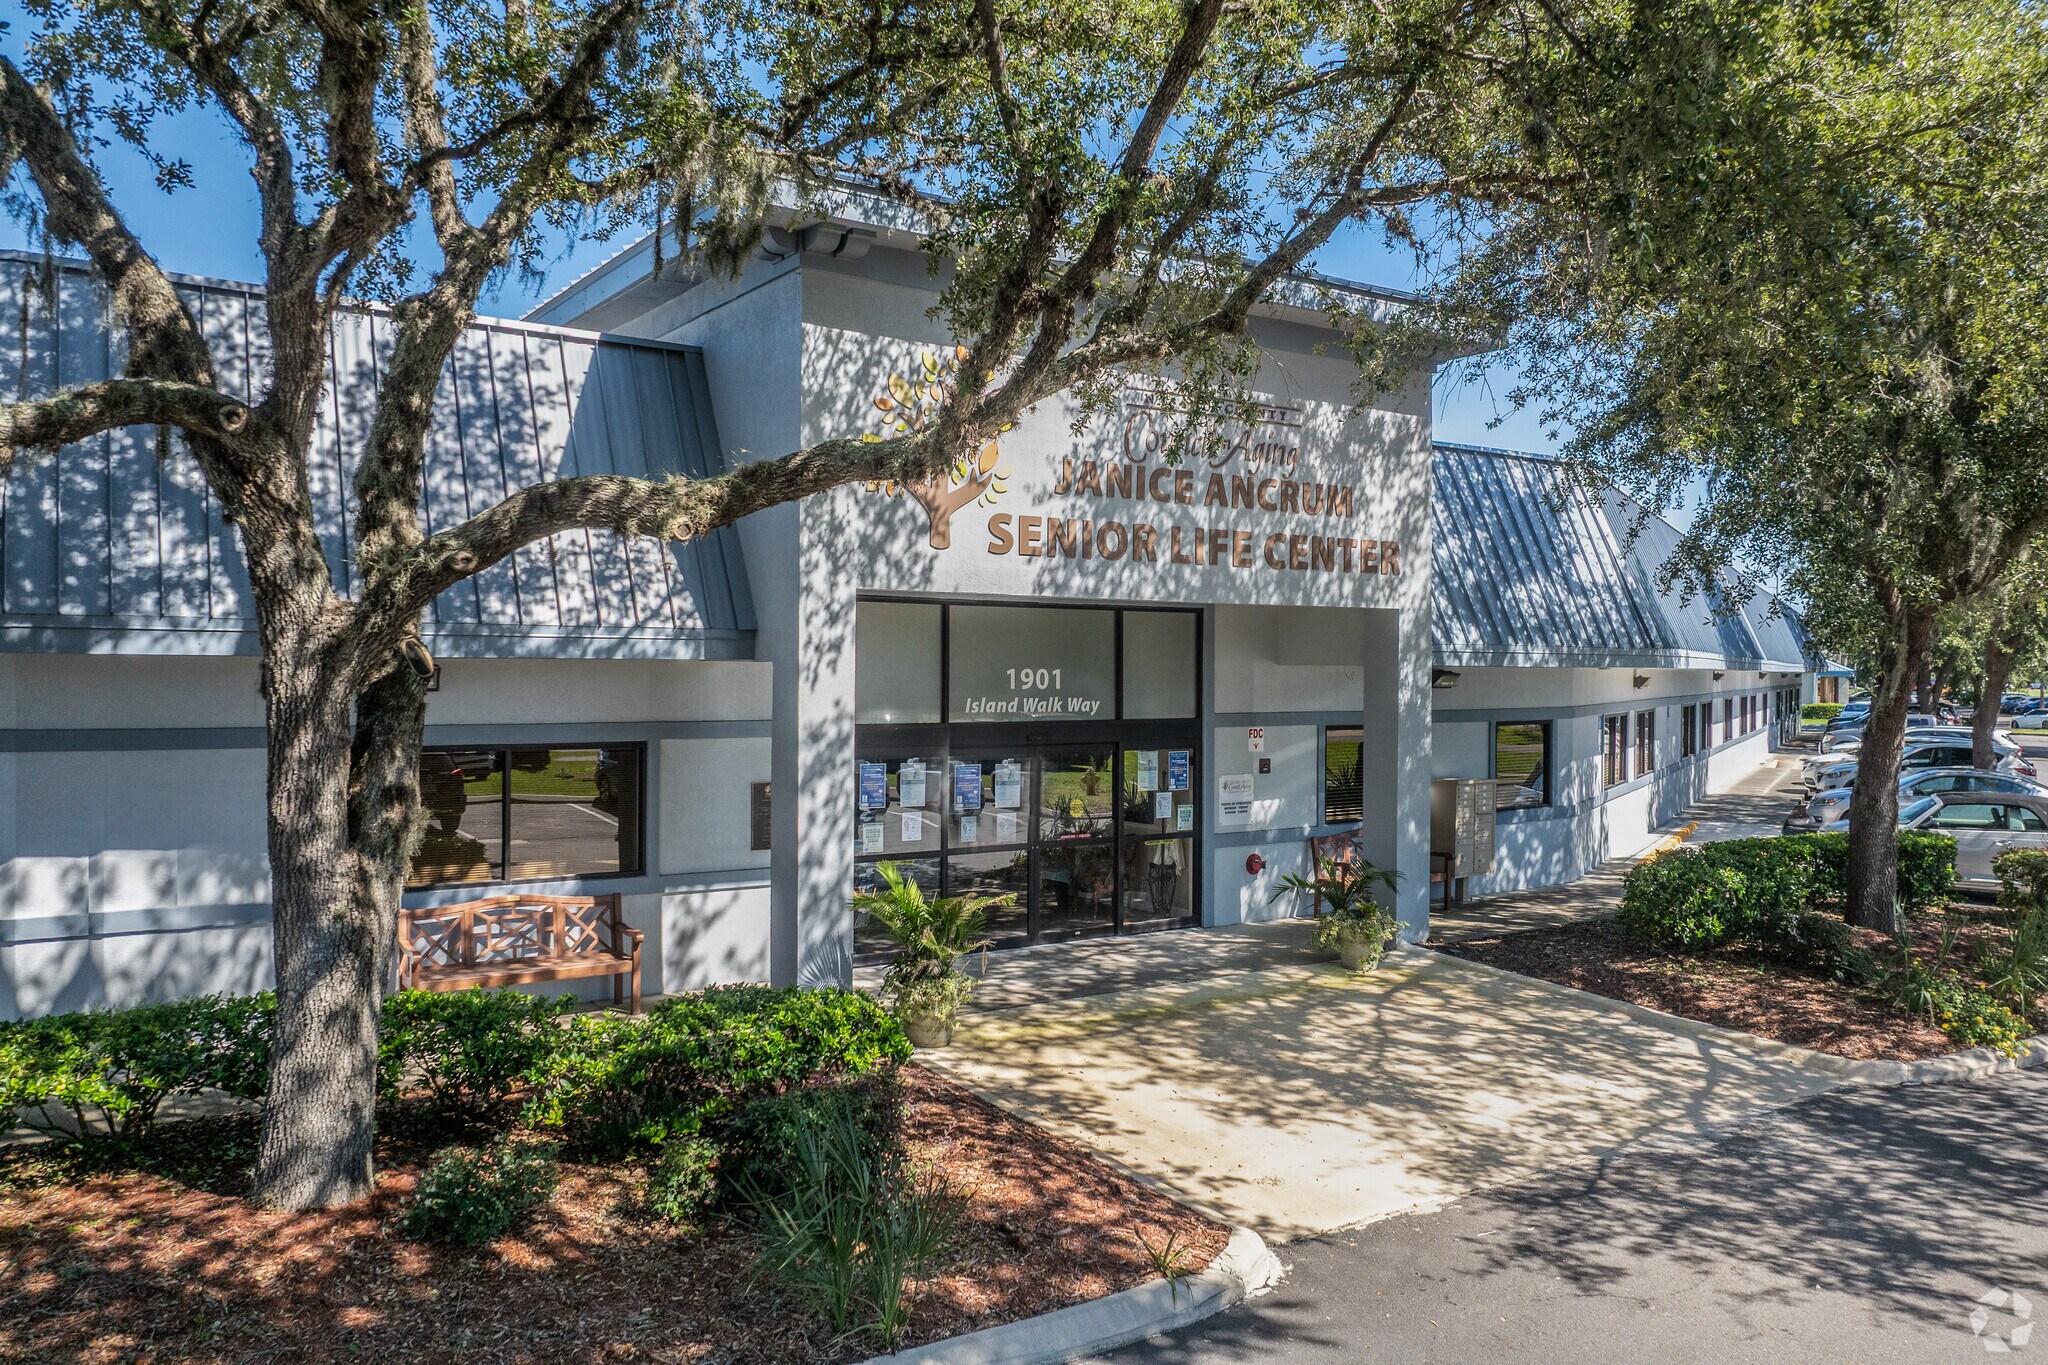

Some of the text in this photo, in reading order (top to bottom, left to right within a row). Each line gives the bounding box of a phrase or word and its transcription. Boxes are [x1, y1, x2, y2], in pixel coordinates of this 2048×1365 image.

[1224, 402, 1288, 421] CNTY
[1209, 428, 1300, 479] Aging
[1054, 457, 1354, 518] JANICE ANCRUM
[987, 512, 1401, 576] SENIOR LIFE CENTER
[1006, 668, 1061, 690] 1901
[965, 696, 1101, 717] Island Walk Way
[1248, 728, 1264, 739] FDC
